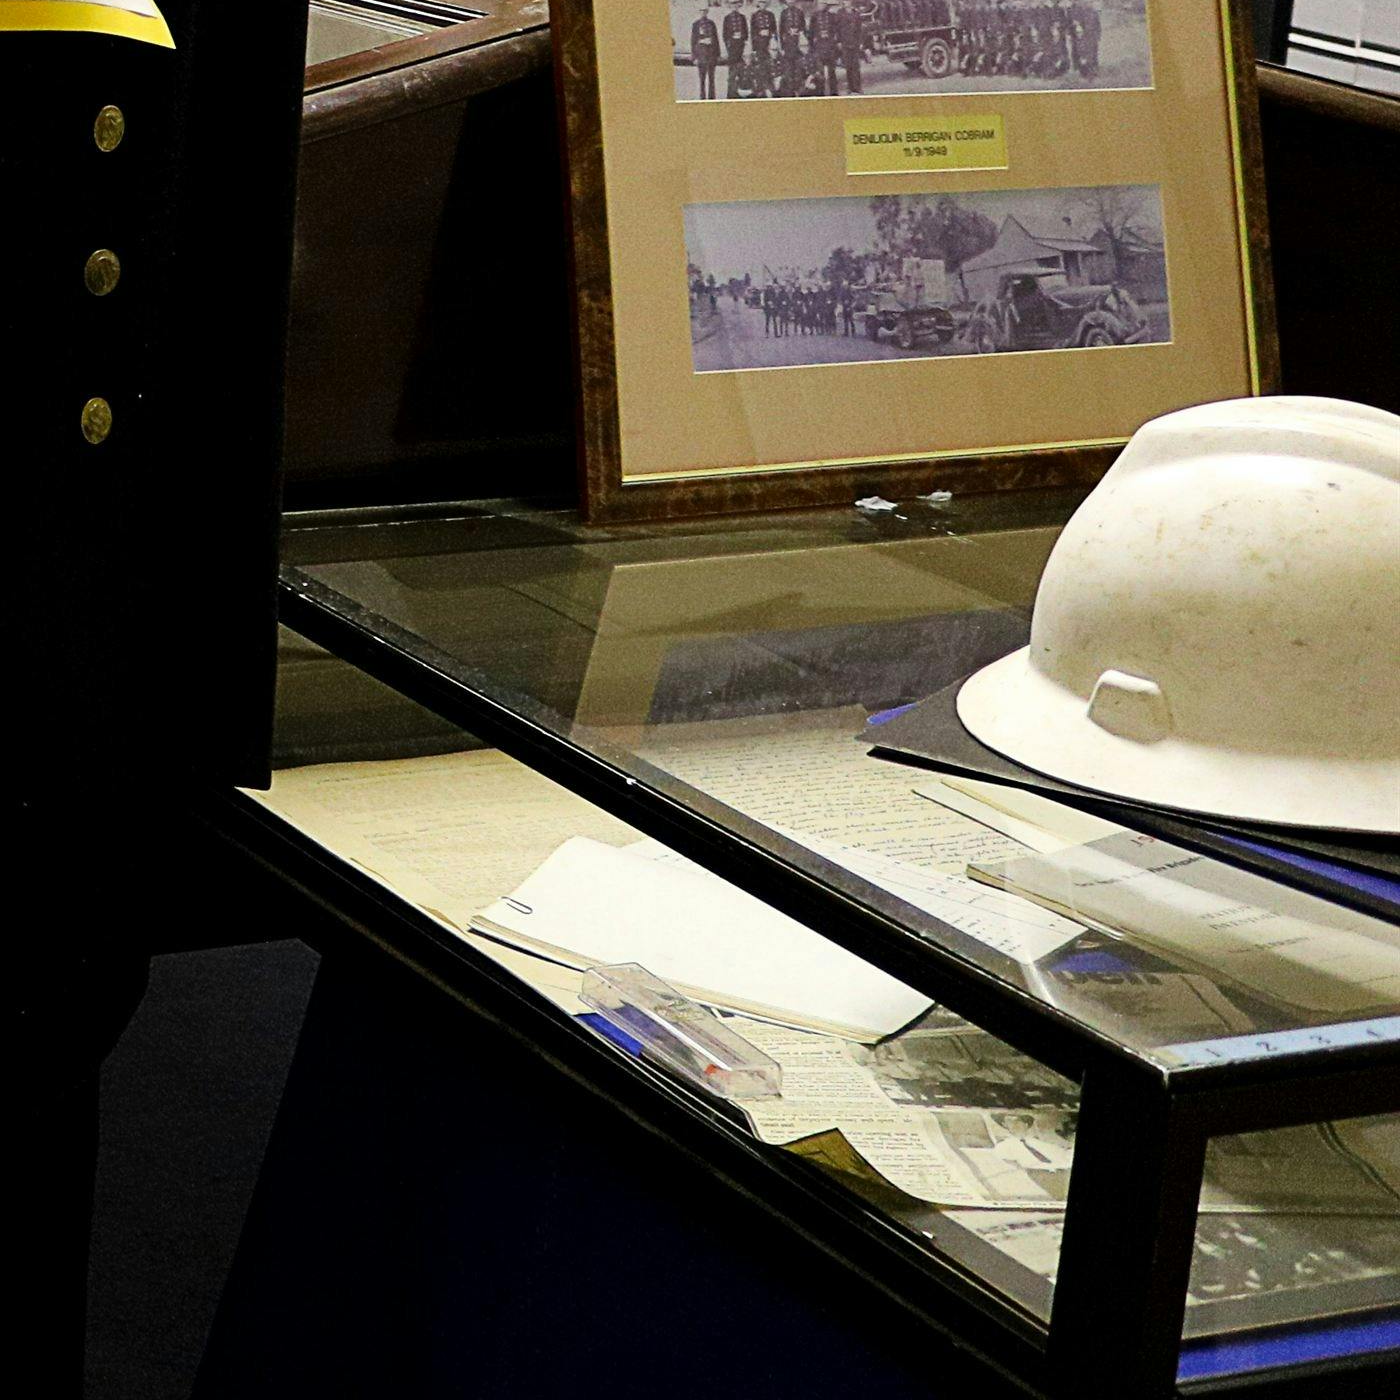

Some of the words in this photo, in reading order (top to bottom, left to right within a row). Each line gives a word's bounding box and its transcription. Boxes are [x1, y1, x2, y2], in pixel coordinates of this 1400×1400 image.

[853, 133, 903, 145] DENILIQUIN
[906, 131, 951, 143] BERRIGAN
[955, 129, 995, 141] COBRAM
